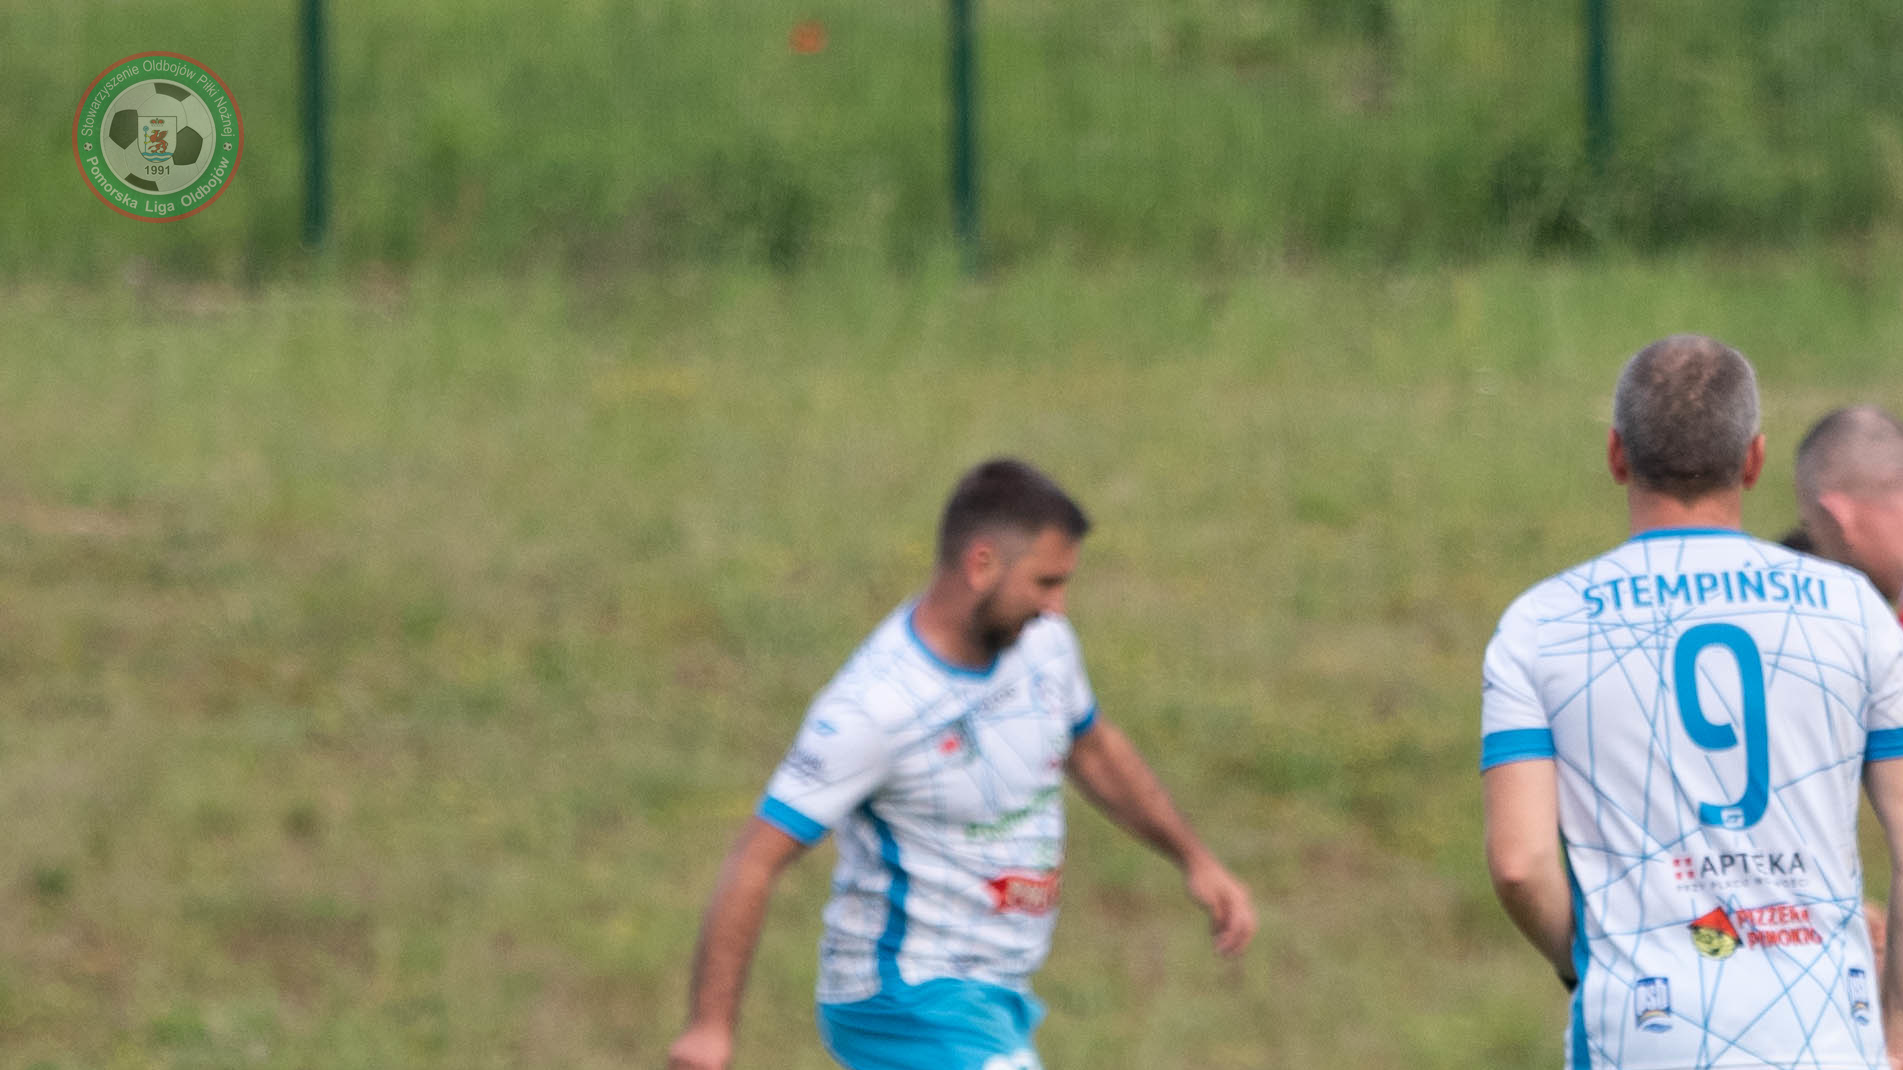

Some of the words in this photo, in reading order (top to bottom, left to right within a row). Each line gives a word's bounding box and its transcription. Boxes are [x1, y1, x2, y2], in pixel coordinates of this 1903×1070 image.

[1582, 562, 1830, 618] STEMPIŃSKI
[1673, 622, 1770, 832] 9
[1701, 853, 1806, 878] APTEKA
